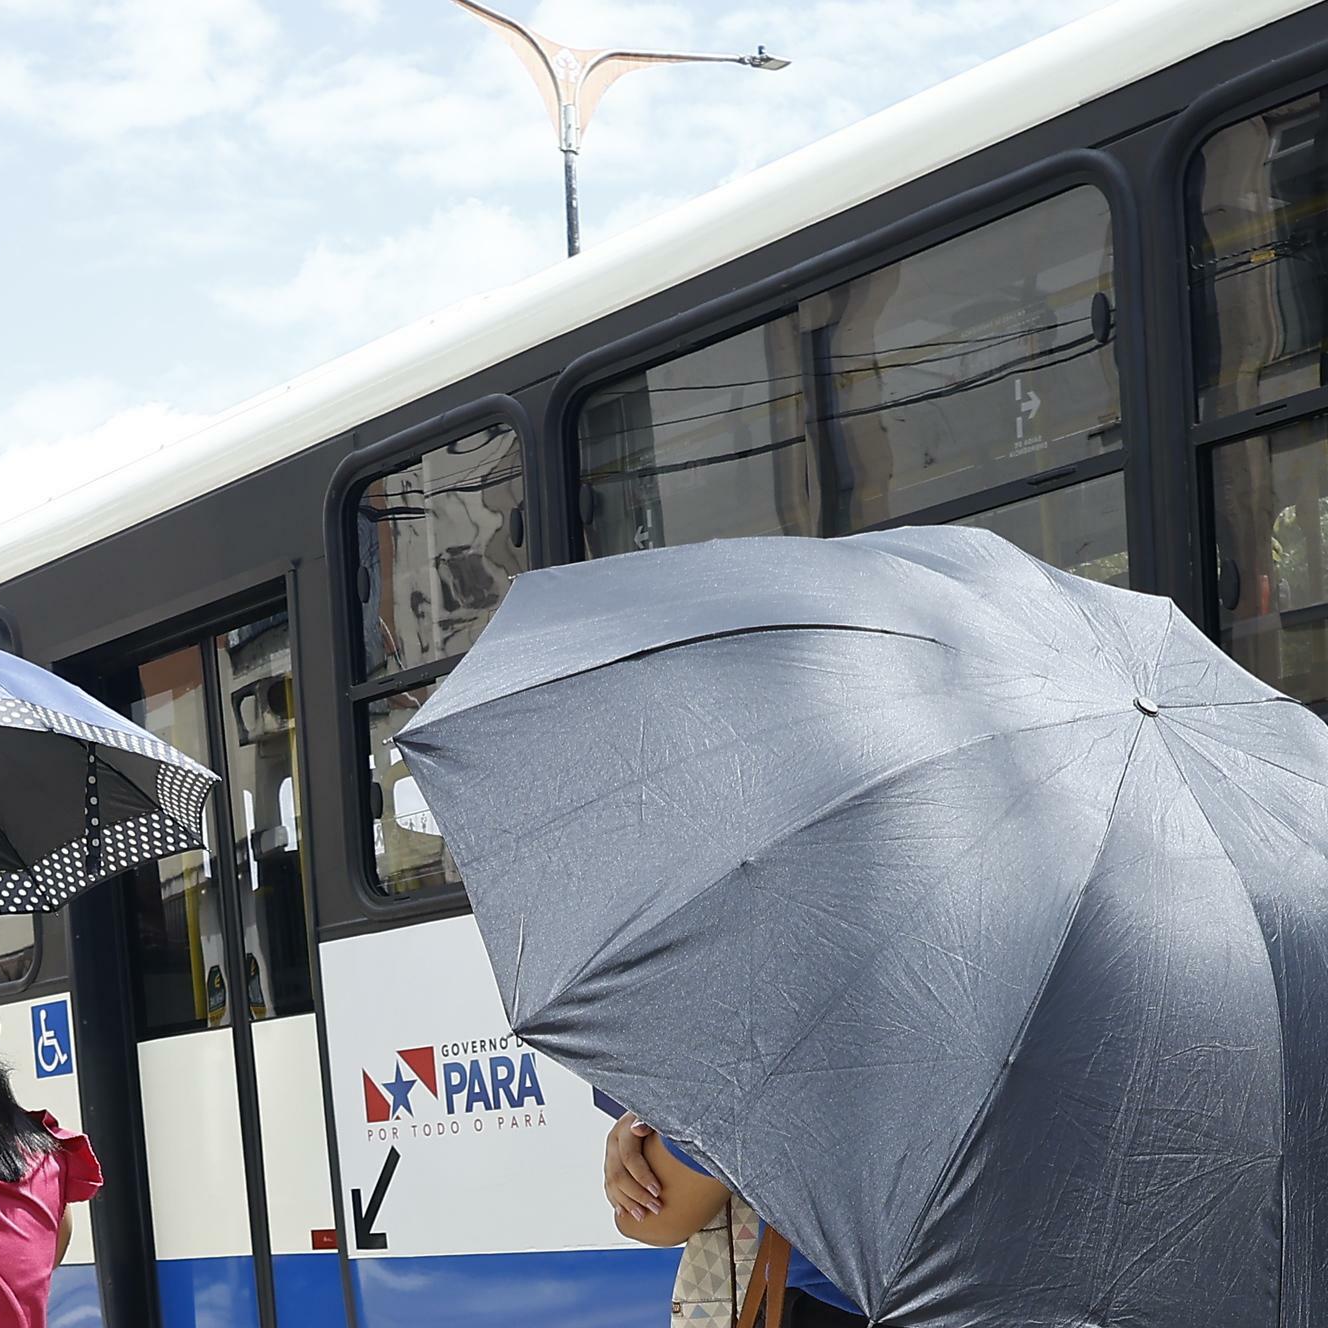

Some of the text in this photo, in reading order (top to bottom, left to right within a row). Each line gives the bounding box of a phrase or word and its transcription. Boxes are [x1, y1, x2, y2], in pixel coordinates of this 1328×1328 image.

[441, 1035, 524, 1058] GOVERNO D
[367, 1110, 547, 1142] POR TODO O PARÁ
